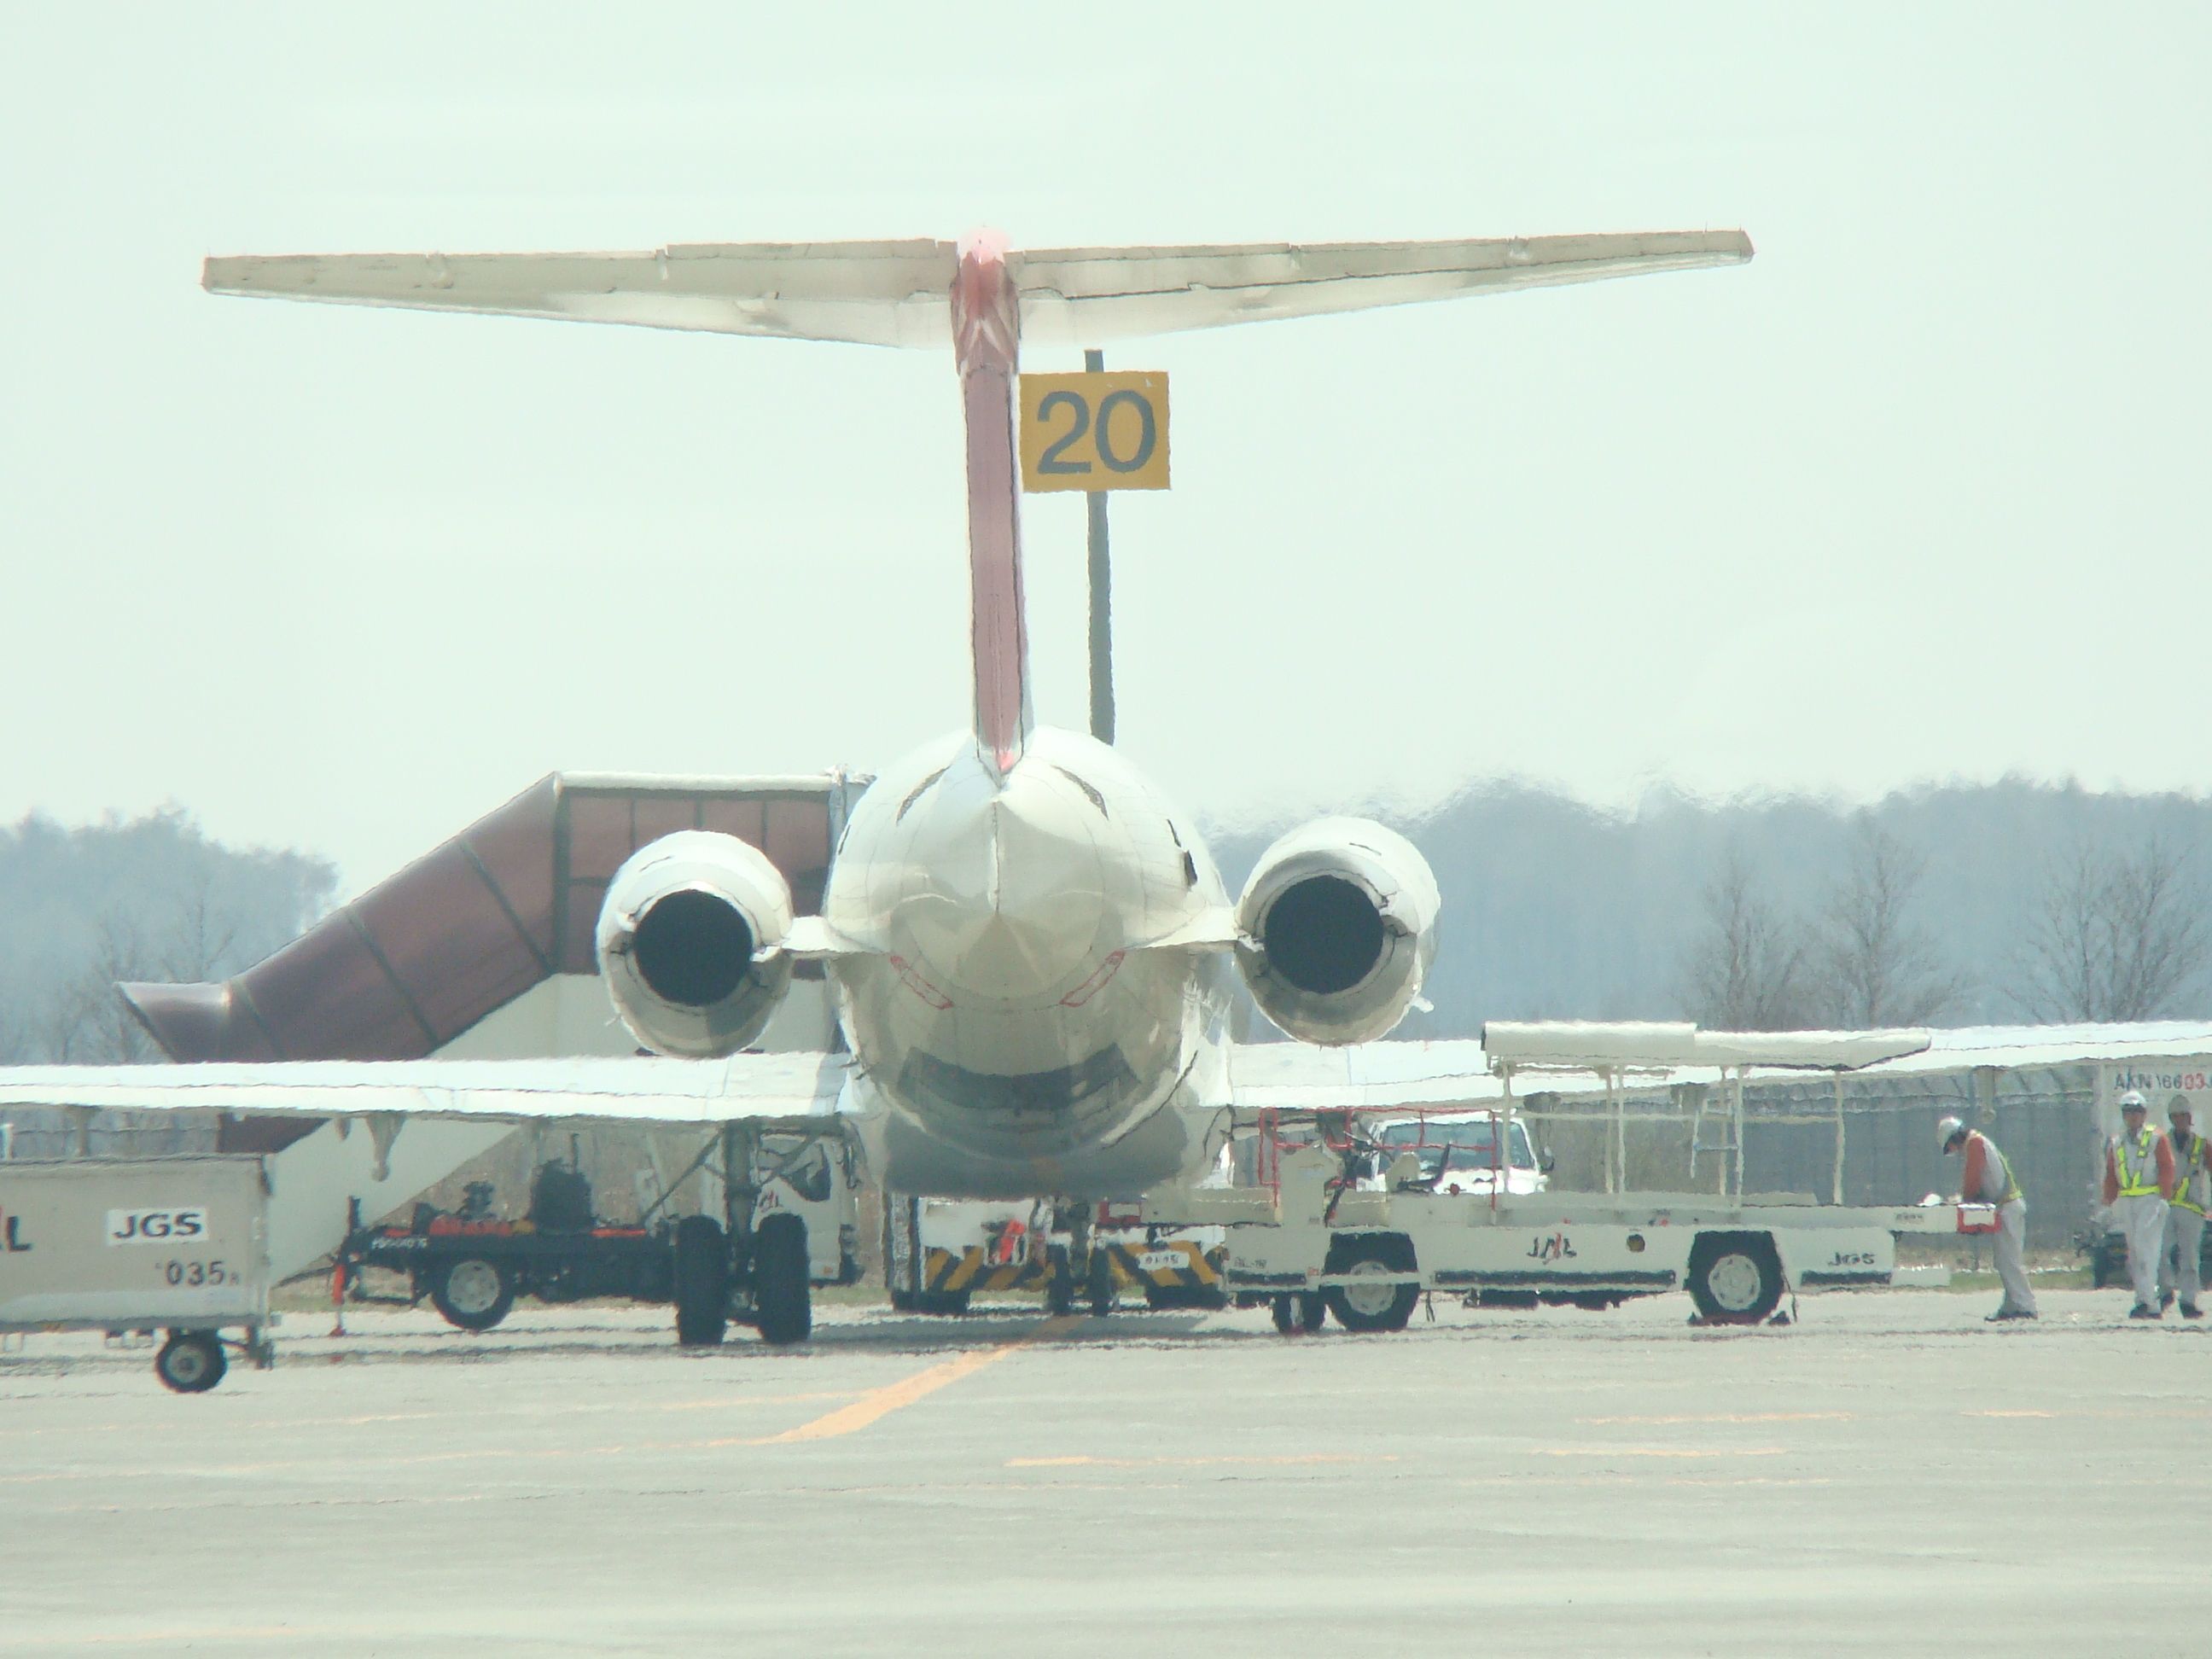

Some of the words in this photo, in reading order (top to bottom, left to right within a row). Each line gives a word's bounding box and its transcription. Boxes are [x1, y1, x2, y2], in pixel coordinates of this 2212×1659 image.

[1037, 389, 1156, 474] 20
[0, 1205, 32, 1252] L
[113, 1212, 202, 1238] JGS
[166, 1260, 224, 1286] 035
